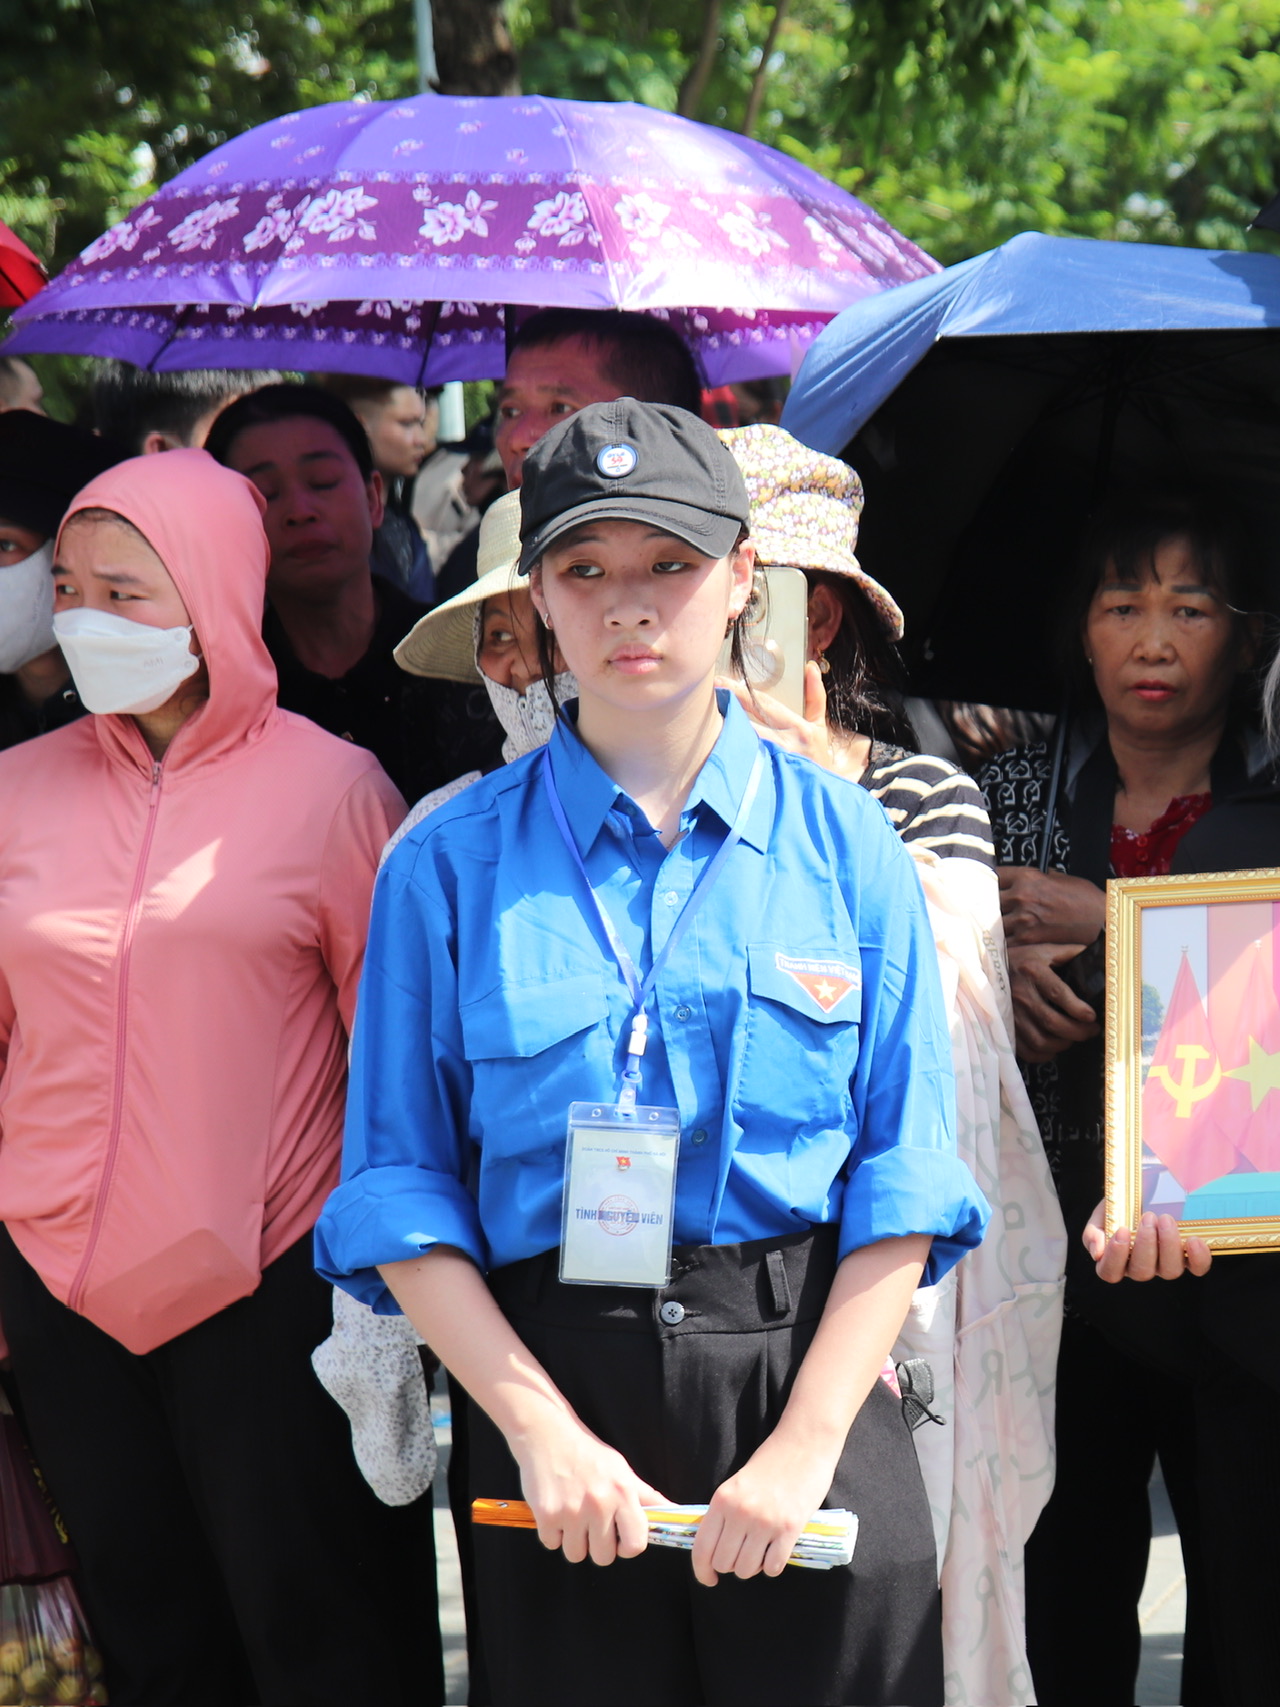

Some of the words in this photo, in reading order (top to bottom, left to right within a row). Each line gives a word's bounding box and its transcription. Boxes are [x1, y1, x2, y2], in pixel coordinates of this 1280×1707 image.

[575, 1207, 597, 1220] TÌNH
[598, 1209, 640, 1224] GUYỆ
[641, 1211, 663, 1225] VIÊN
